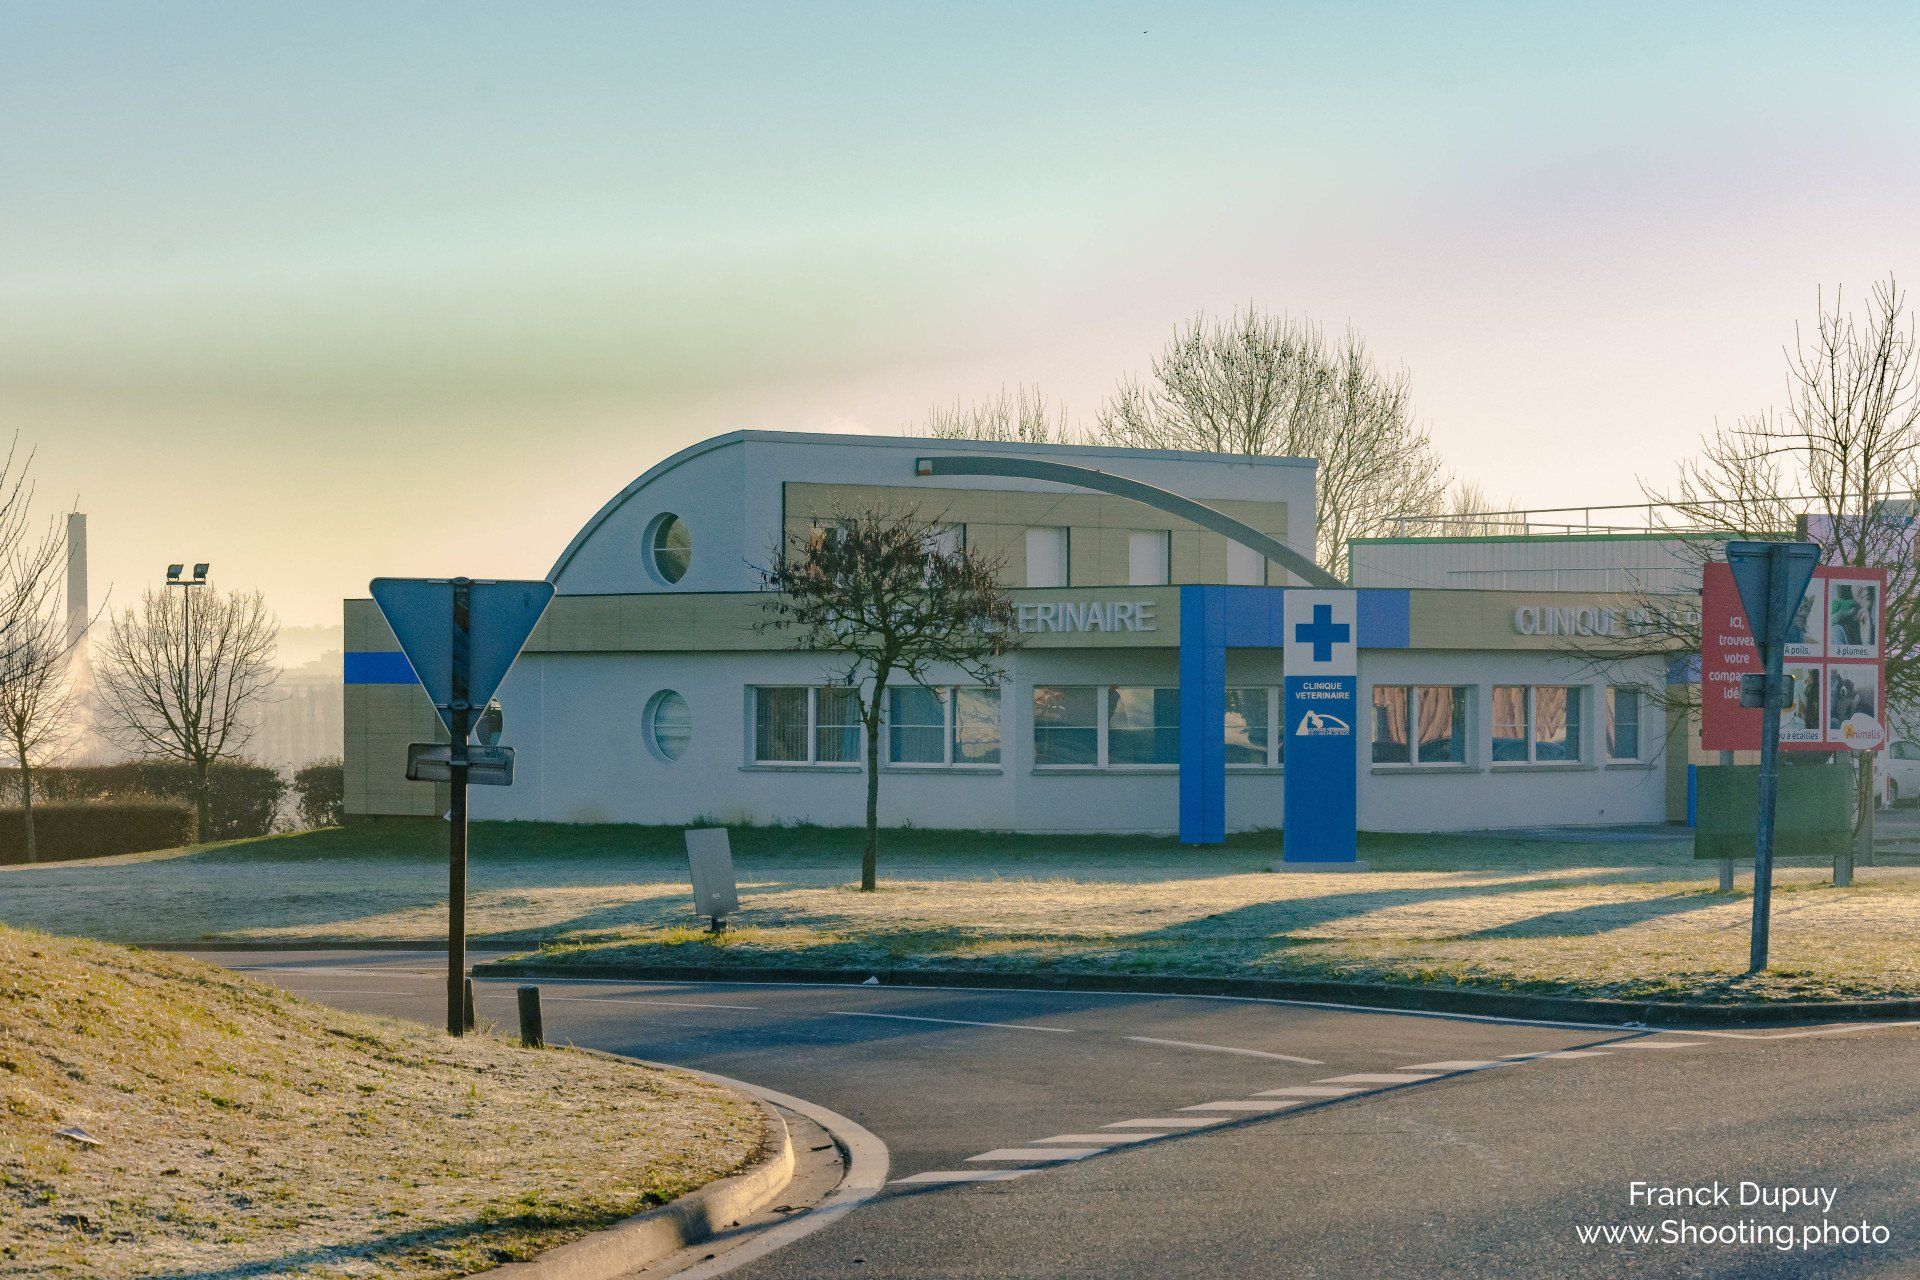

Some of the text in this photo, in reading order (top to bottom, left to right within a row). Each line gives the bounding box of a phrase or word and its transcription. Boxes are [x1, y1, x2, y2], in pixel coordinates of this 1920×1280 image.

[980, 601, 1157, 632] ERINAIRE
[1514, 606, 1619, 636] CLINIQUE
[1719, 635, 1755, 646] trouvez
[1724, 653, 1750, 665] votre
[1709, 672, 1742, 684] compa
[1303, 682, 1342, 690] CLINIQUE
[1723, 687, 1740, 700] idé
[1792, 730, 1819, 741] écailles
[1846, 727, 1881, 740] Animalis
